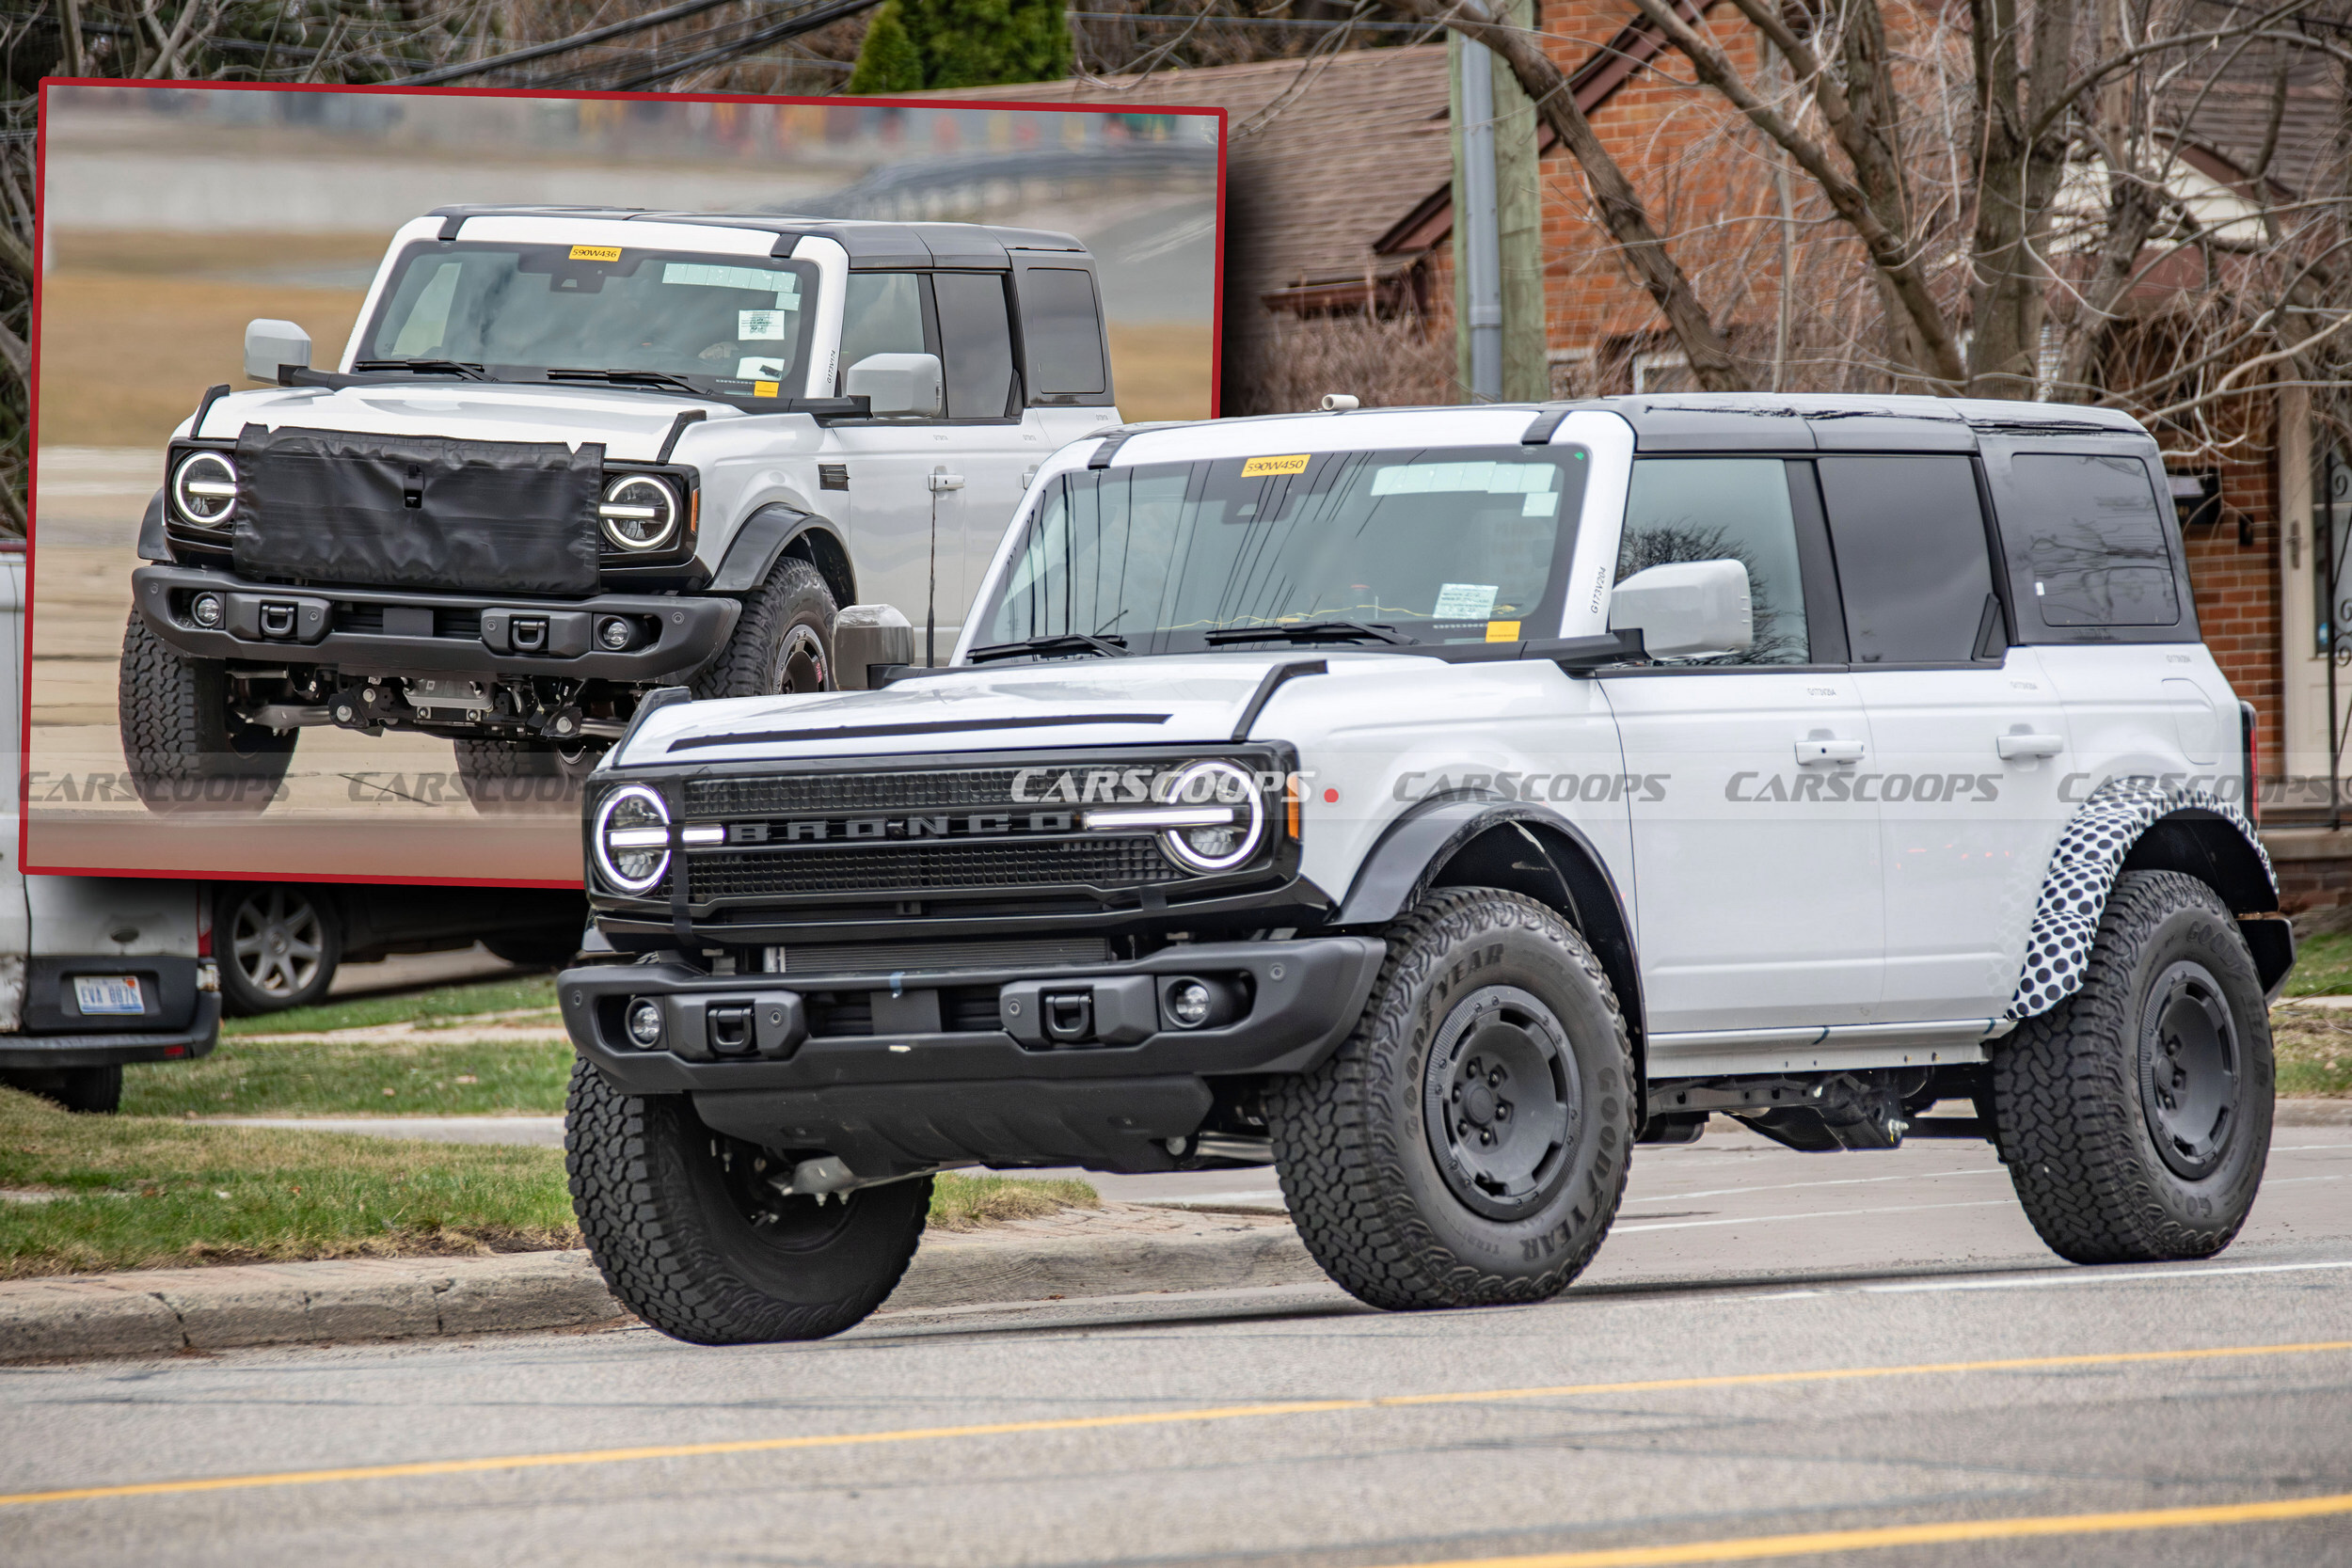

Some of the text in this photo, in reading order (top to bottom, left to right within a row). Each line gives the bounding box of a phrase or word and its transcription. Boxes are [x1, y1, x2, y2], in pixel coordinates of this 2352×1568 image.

[1246, 455, 1305, 473] 590W450
[1590, 565, 1607, 614] G173V204
[728, 811, 1075, 843] BRONCO
